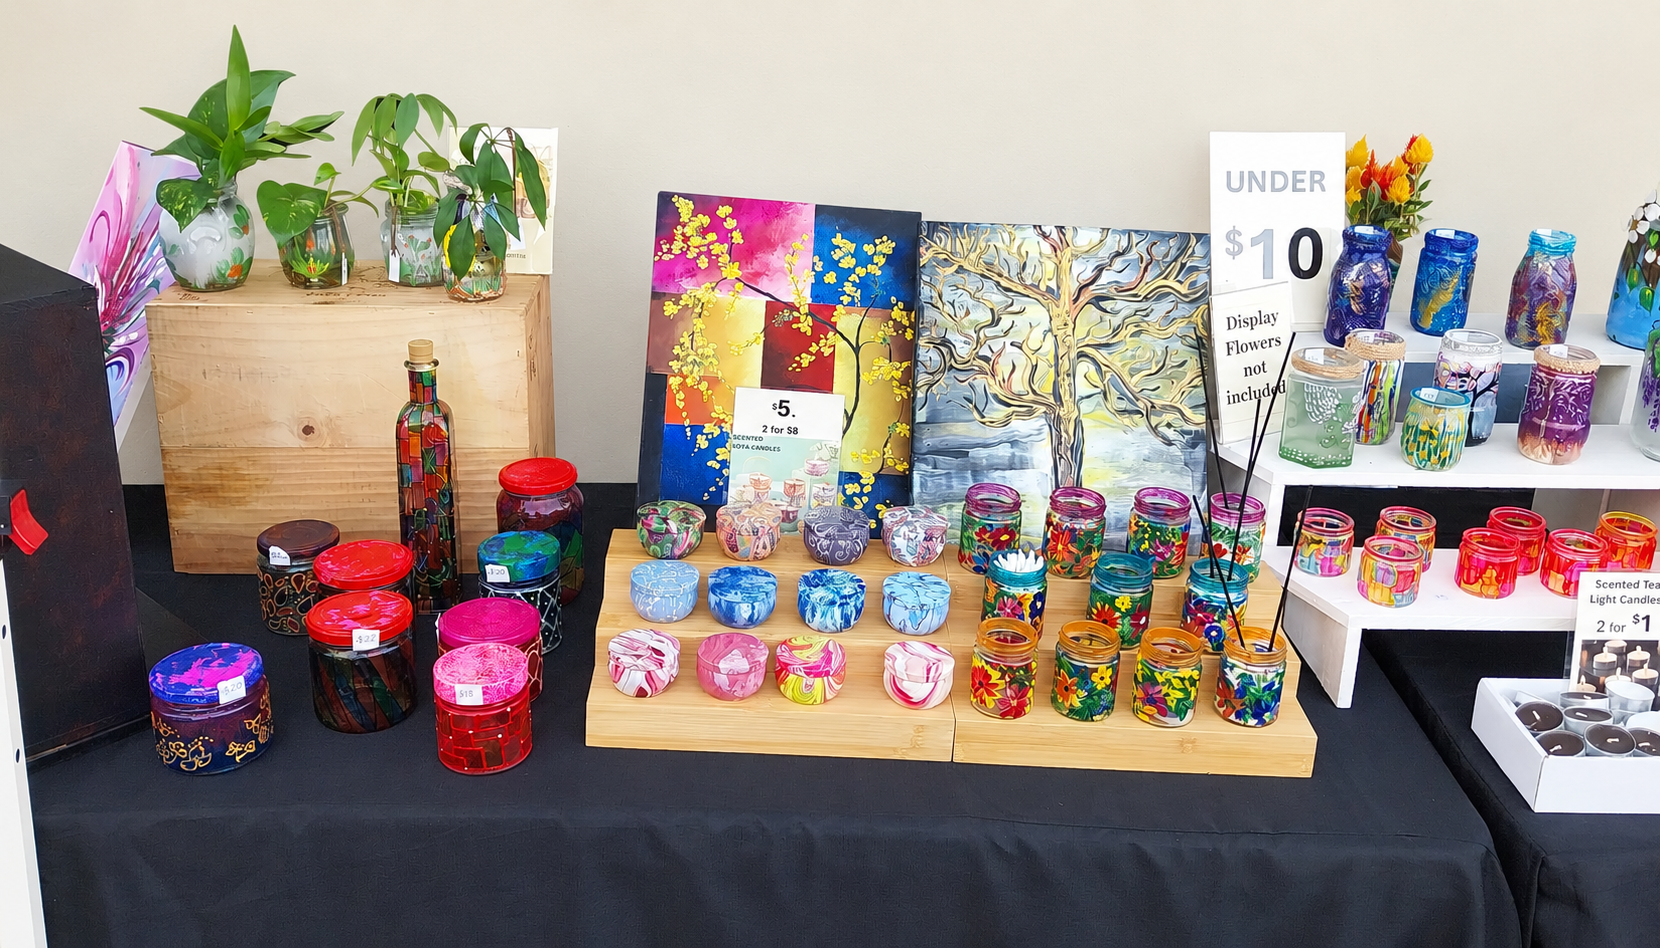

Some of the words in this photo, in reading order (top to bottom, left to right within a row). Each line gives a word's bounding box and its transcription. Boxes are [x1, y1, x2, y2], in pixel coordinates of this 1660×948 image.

[1225, 170, 1326, 193] UNDER
[1225, 225, 1323, 280] $10
[1226, 310, 1279, 331] Display
[1225, 336, 1282, 356] Flowers
[1243, 360, 1268, 378] not
[1226, 379, 1286, 405] included
[761, 424, 768, 433] 2
[770, 425, 785, 434] for
[786, 425, 799, 435] $8
[1595, 579, 1640, 589] Scented
[1643, 580, 1660, 590] Tea
[1590, 594, 1617, 606] Light
[1619, 595, 1660, 605] Candles
[1596, 620, 1605, 632] 2
[1609, 622, 1626, 632] for
[1632, 613, 1650, 632] $1
